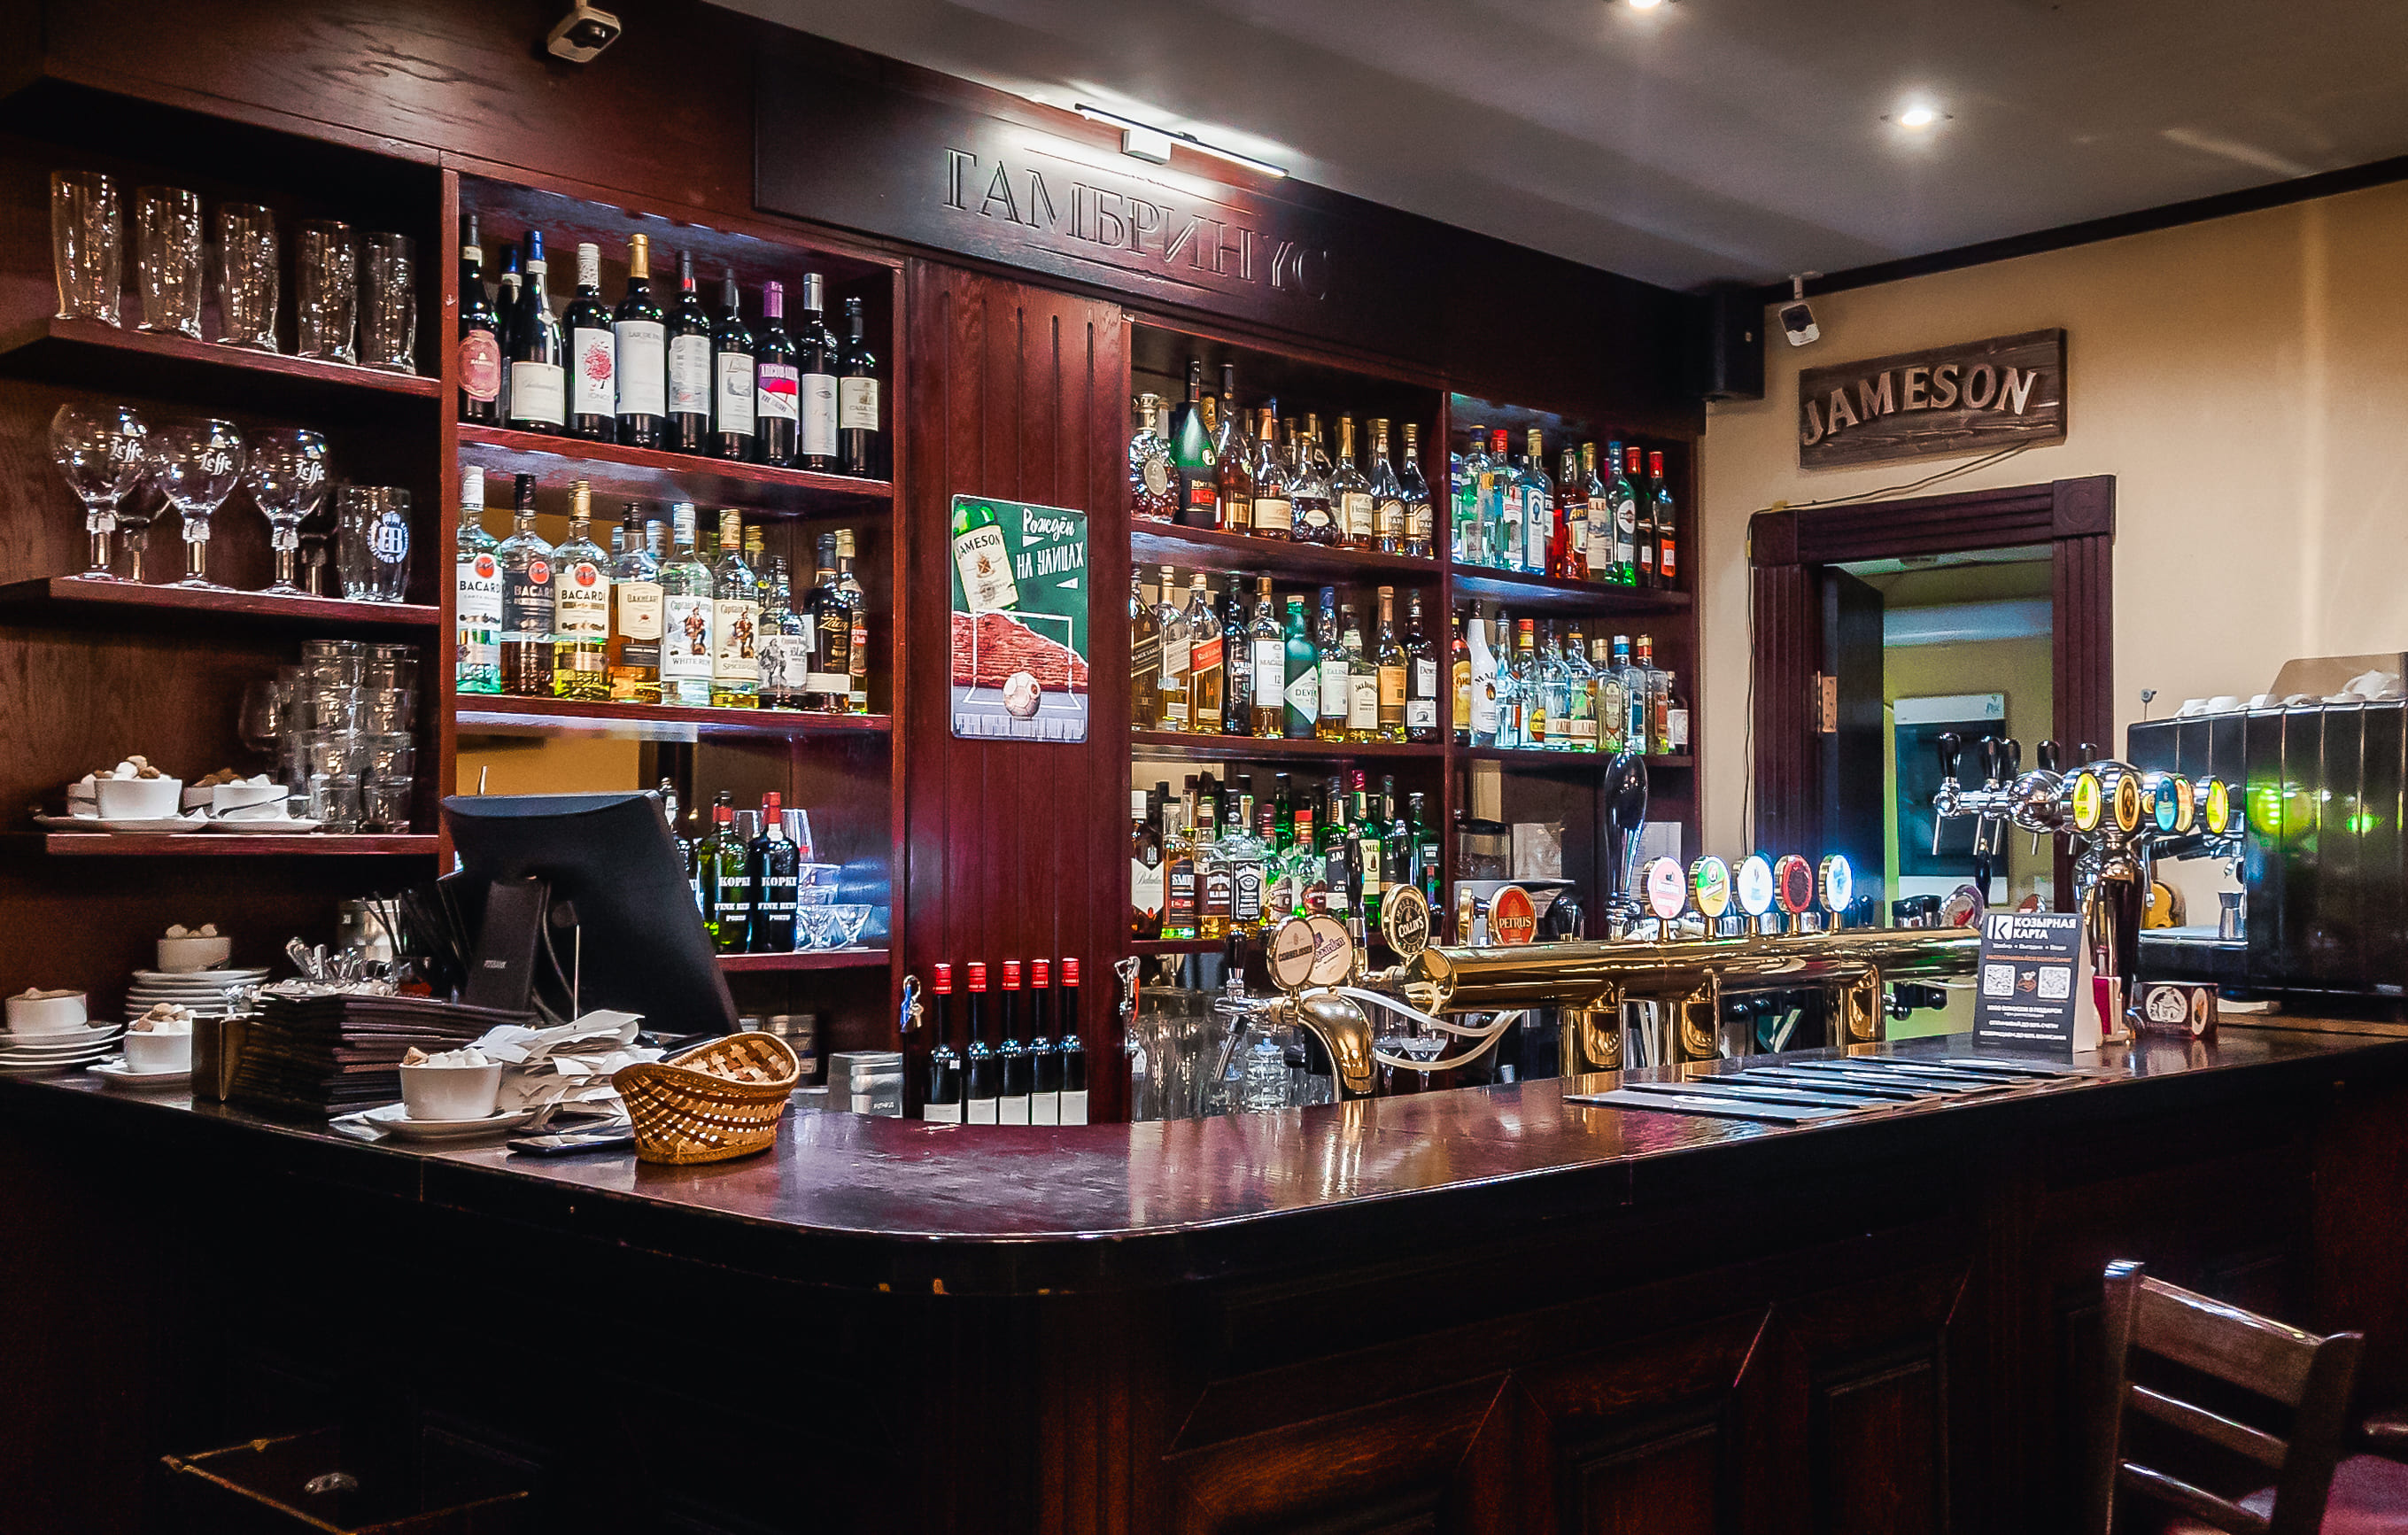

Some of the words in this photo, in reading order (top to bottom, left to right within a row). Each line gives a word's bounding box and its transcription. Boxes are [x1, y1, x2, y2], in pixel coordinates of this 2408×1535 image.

[941, 145, 1331, 302] ГАМБРИНУС
[1802, 362, 2037, 446] JAMESON
[108, 437, 144, 463] Leffe
[198, 451, 233, 476] Leffe
[294, 461, 325, 485] Leffe
[956, 533, 1001, 560] JAMESON
[1016, 552, 1034, 580] НА
[1036, 541, 1084, 577] УЛИЦАХ
[672, 657, 698, 666] WHITE
[1274, 675, 1281, 685] 12
[1498, 916, 1532, 931] PETRUS
[2012, 928, 2048, 940] КАРТА
[2013, 916, 2077, 929] КОЗЫРНАЯ
